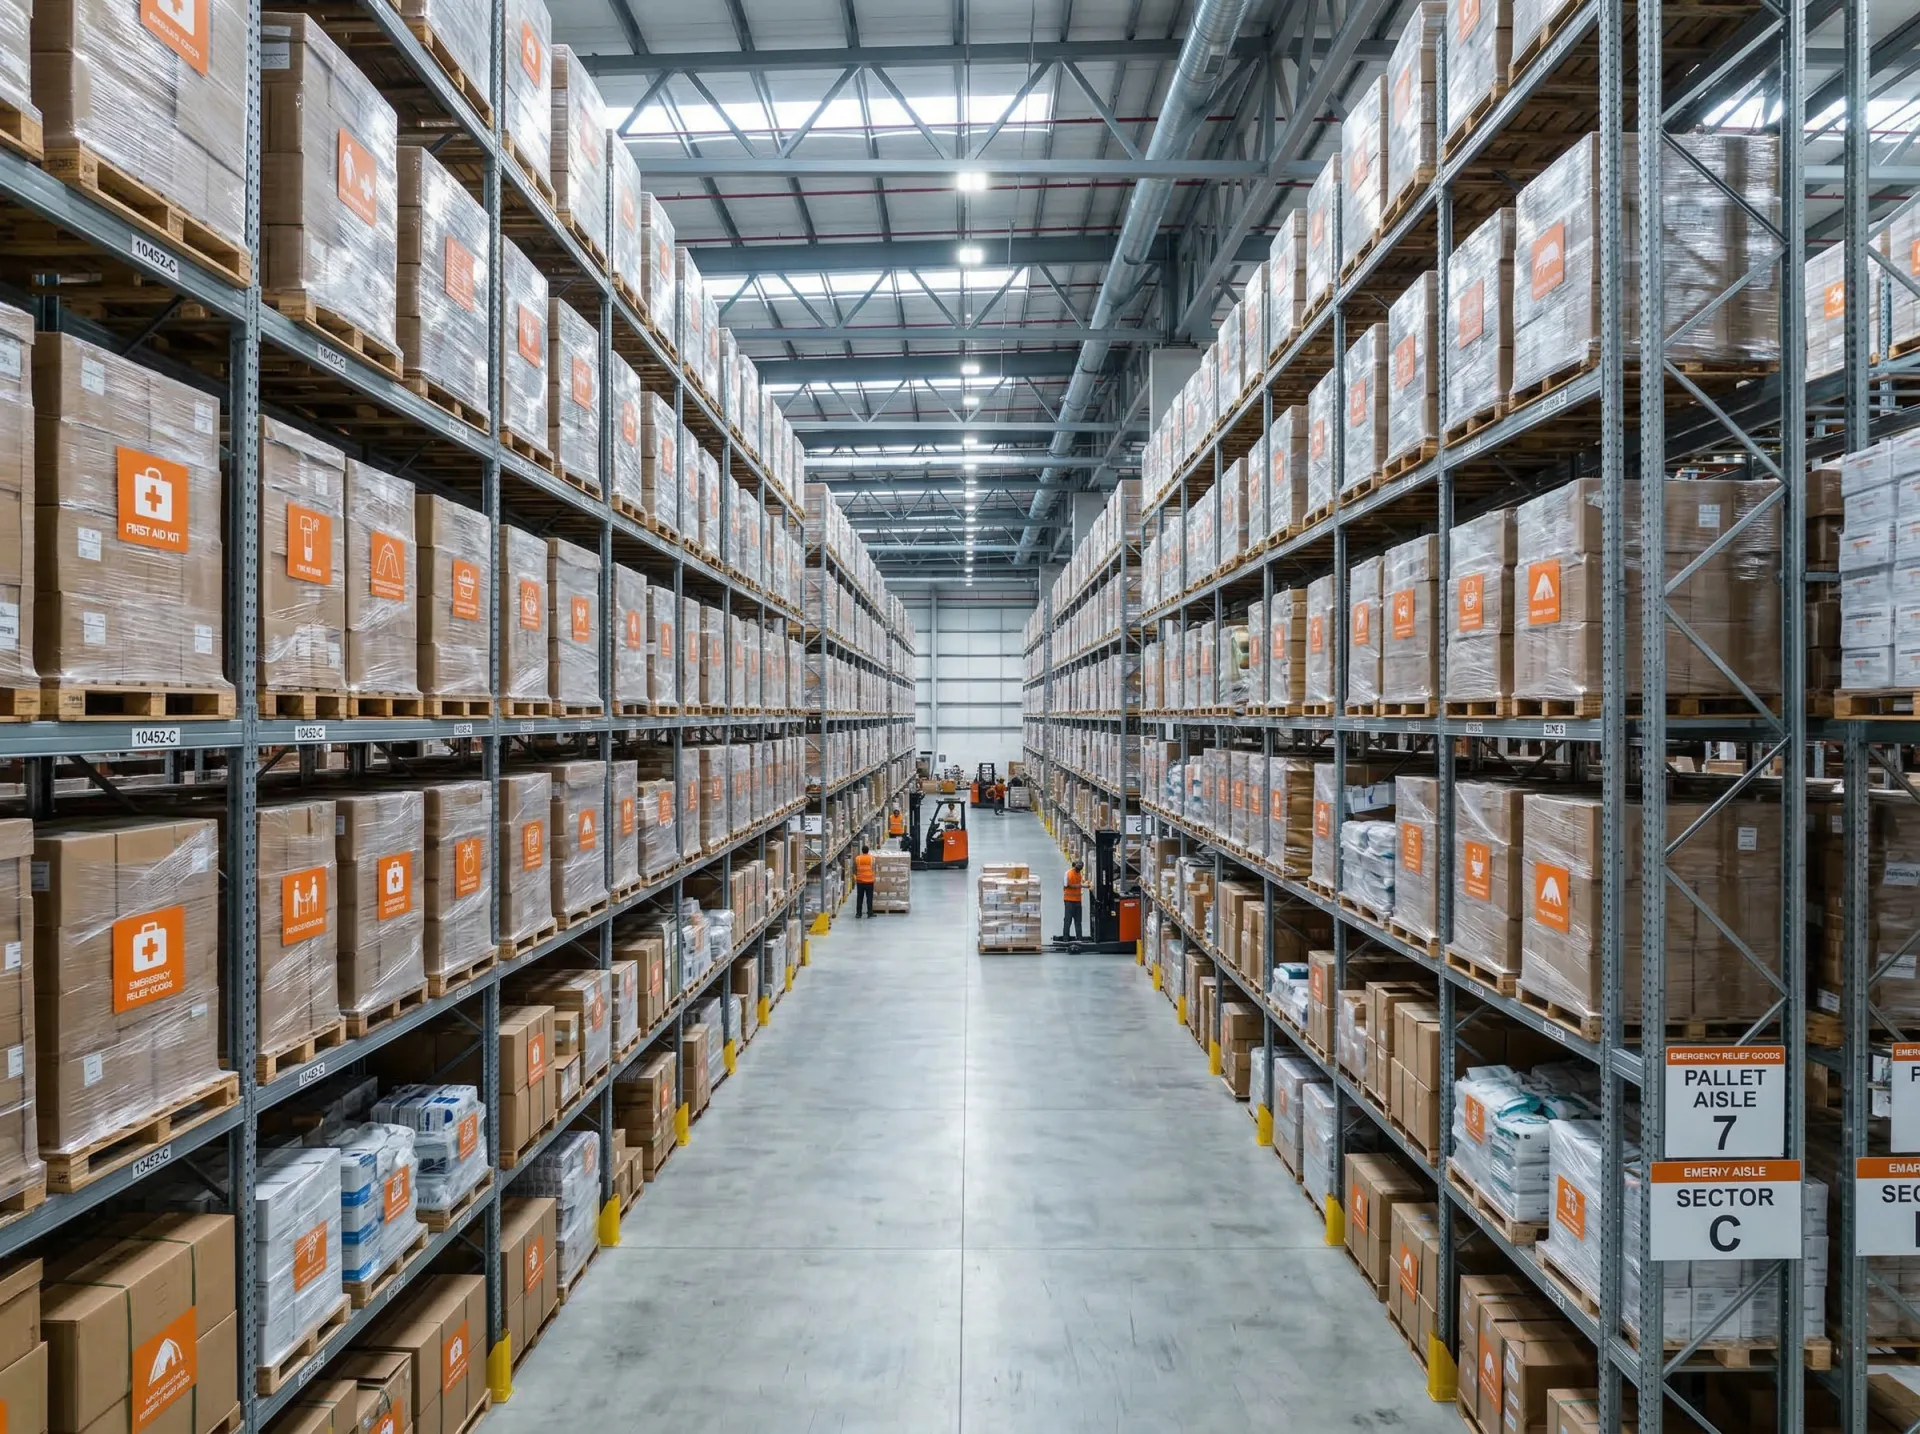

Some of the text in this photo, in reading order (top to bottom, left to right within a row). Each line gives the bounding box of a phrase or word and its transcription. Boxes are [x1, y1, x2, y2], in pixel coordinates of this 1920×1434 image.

[136, 240, 176, 273] 10452-C
[152, 528, 166, 540] AID
[167, 531, 180, 543] KIT
[136, 730, 176, 744] 10452-C
[1670, 1052, 1780, 1060] EMERGENCY RELIEF GOODS
[1684, 1069, 1766, 1086] PALLET
[1693, 1091, 1756, 1108] AISLE
[1713, 1115, 1737, 1150] 7
[1732, 1166, 1766, 1176] AISLE
[1676, 1188, 1774, 1207] SECTOR
[1709, 1214, 1741, 1252] C
